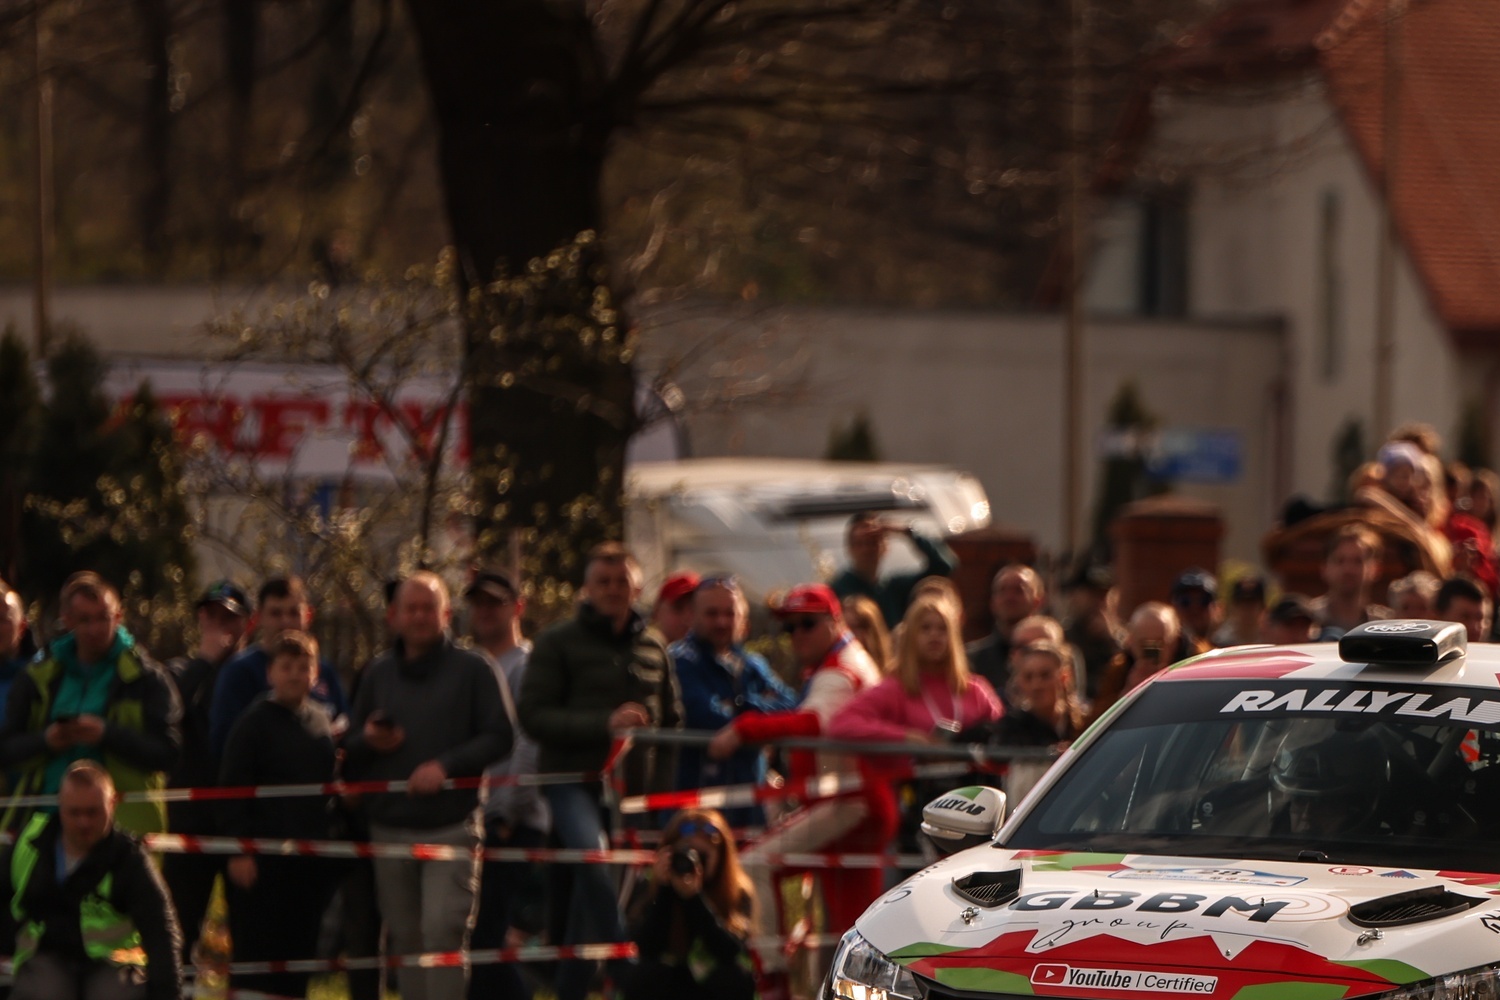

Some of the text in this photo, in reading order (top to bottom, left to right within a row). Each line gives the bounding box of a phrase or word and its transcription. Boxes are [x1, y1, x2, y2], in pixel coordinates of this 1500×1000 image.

[1007, 890, 1291, 923] GBBM
[1032, 916, 1194, 949] group
[1068, 968, 1217, 993] YouTube Certified
